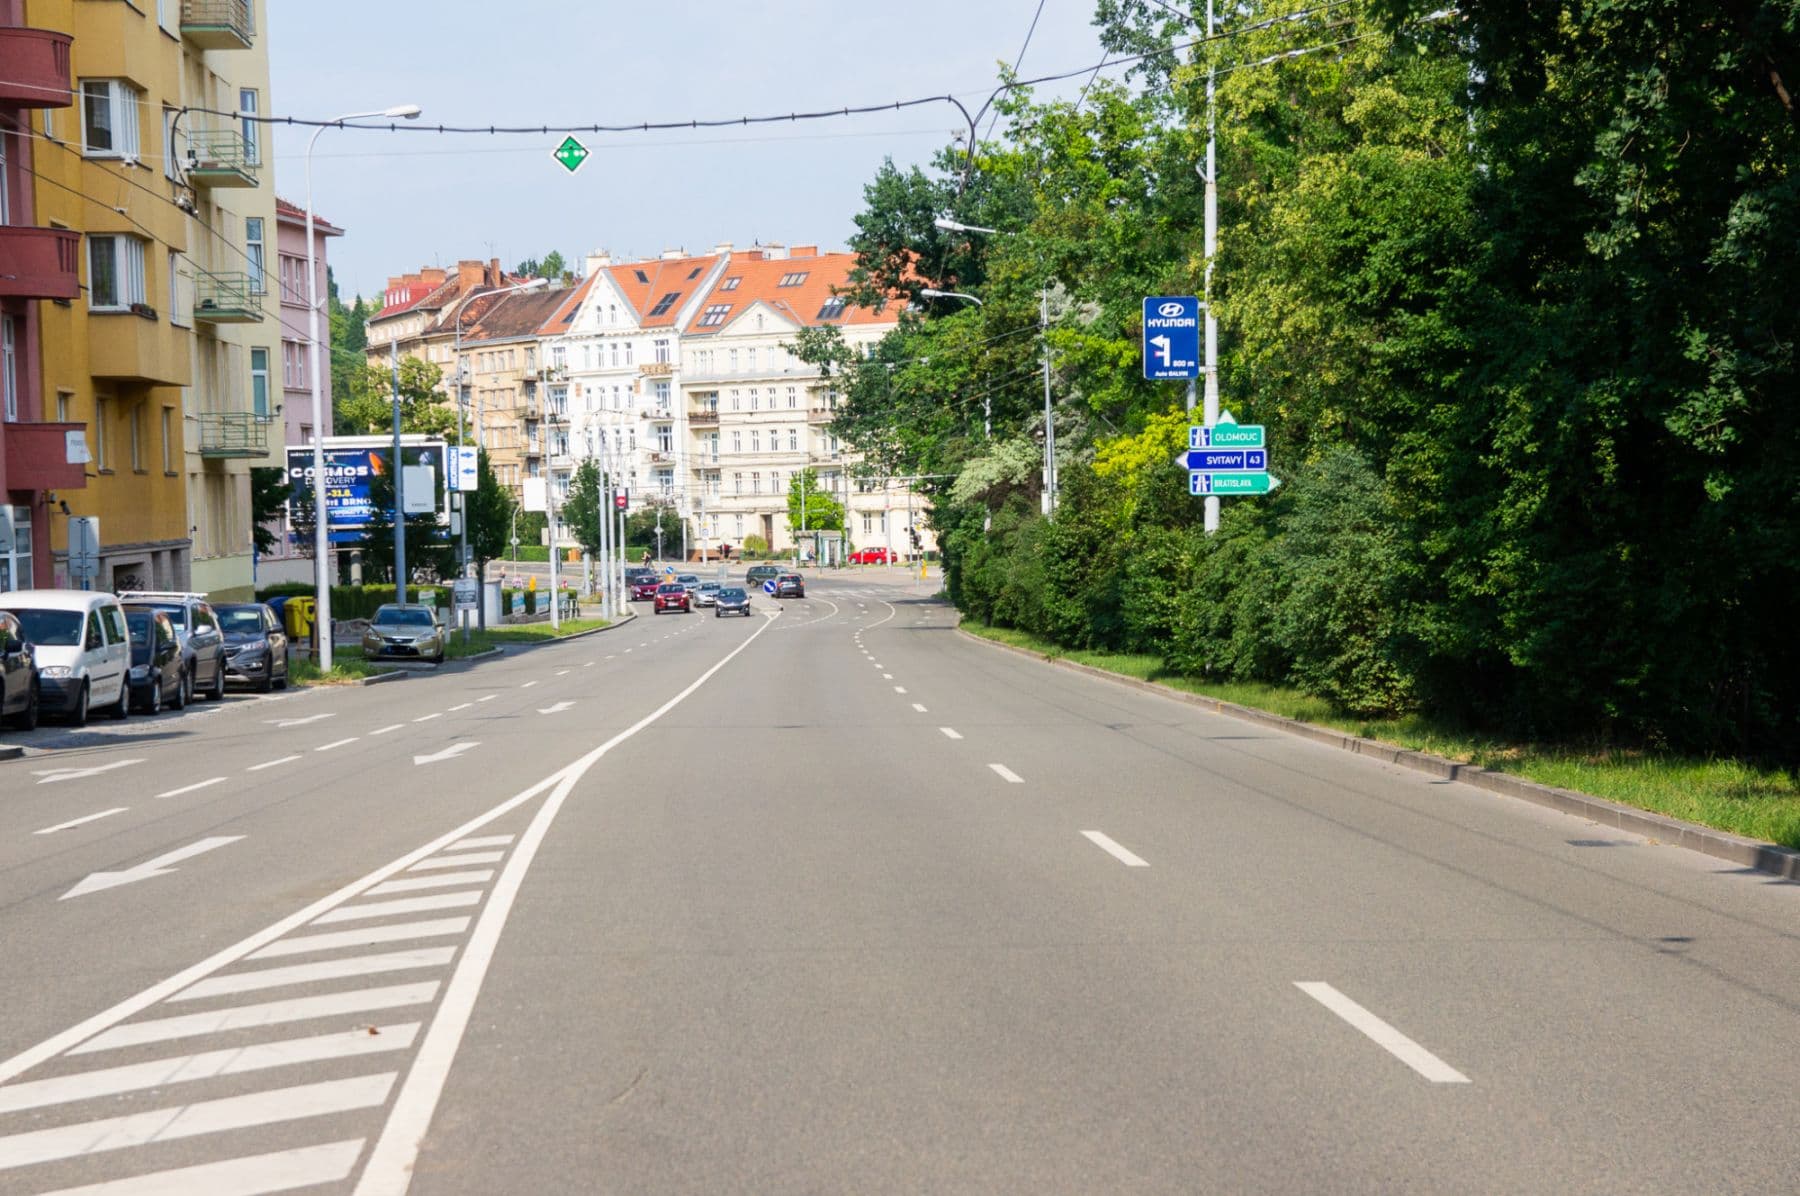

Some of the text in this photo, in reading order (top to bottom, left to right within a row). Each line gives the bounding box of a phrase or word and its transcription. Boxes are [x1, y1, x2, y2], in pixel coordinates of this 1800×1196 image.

[1147, 318, 1195, 327] HYUNDAI
[1215, 432, 1257, 442] OLOMOUC
[1206, 455, 1261, 465] SVITAVY 43
[1214, 478, 1252, 487] BRATISLAVA
